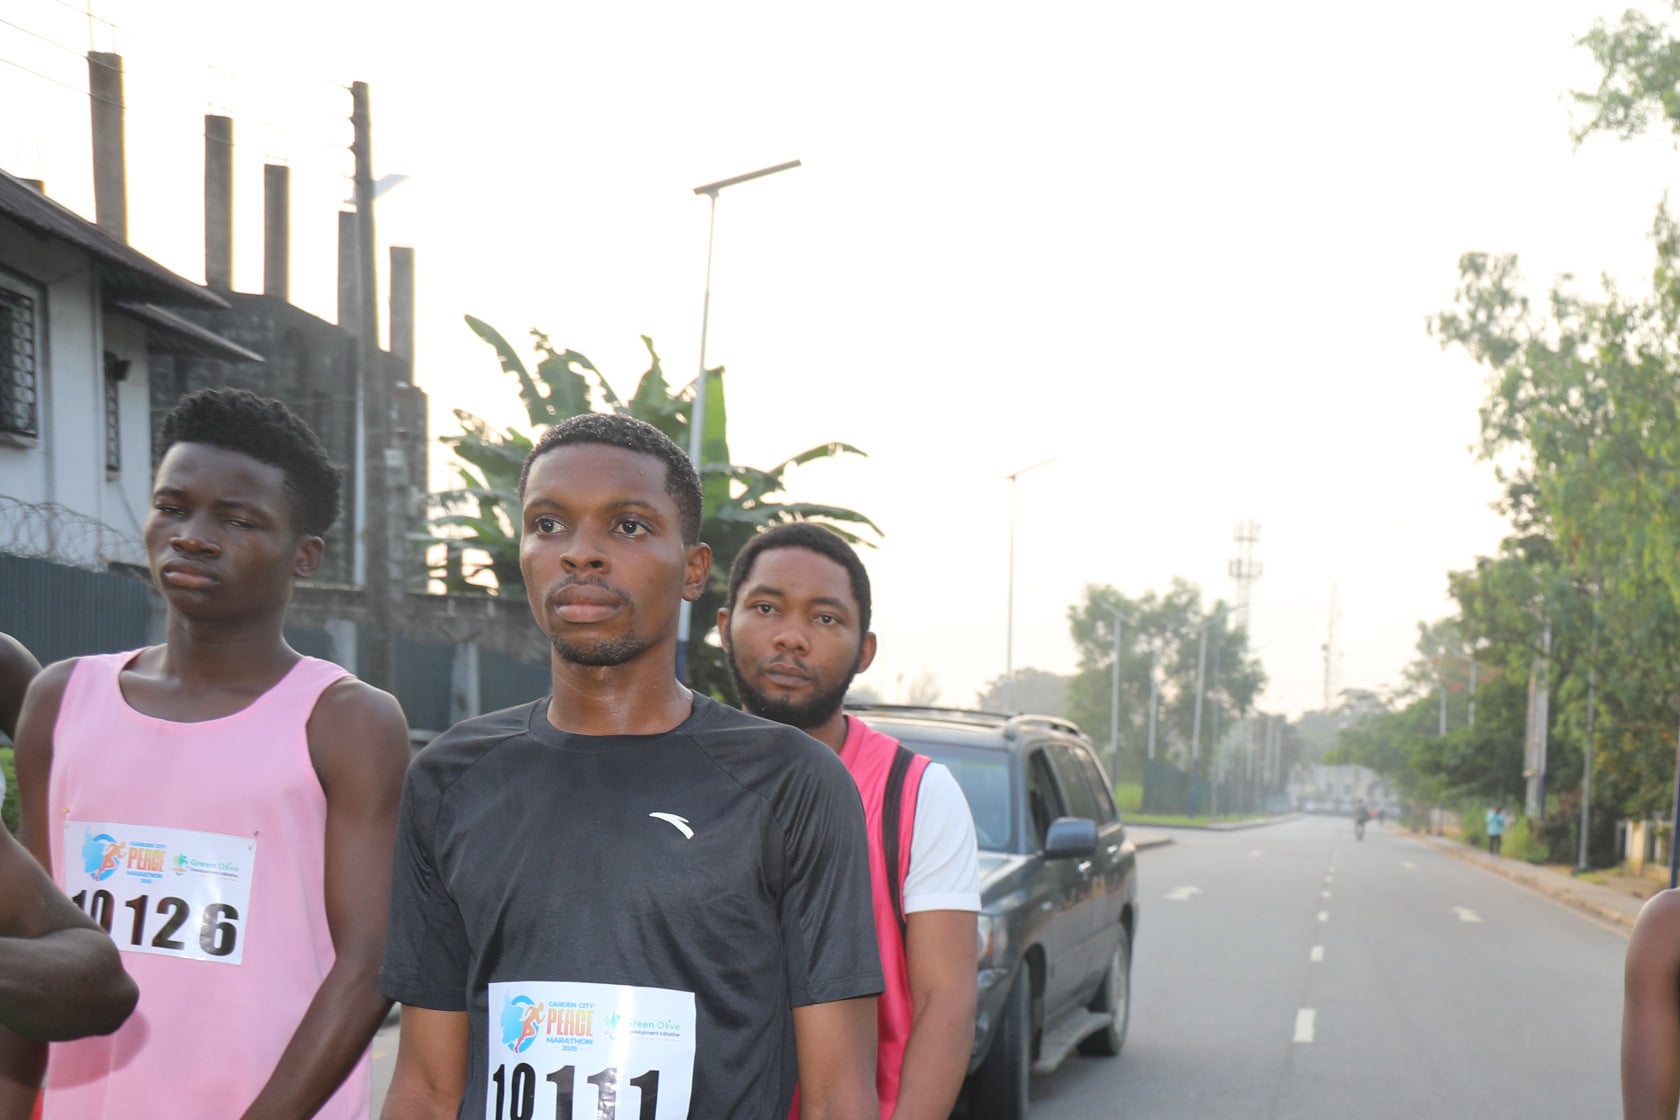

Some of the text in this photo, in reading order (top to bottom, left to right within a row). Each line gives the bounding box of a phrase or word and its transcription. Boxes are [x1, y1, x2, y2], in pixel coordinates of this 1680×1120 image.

[548, 1001, 577, 1009] GARDEN
[546, 1007, 594, 1037] PEACE
[630, 1018, 680, 1031] reen Olive
[546, 1036, 593, 1046] MARATHON
